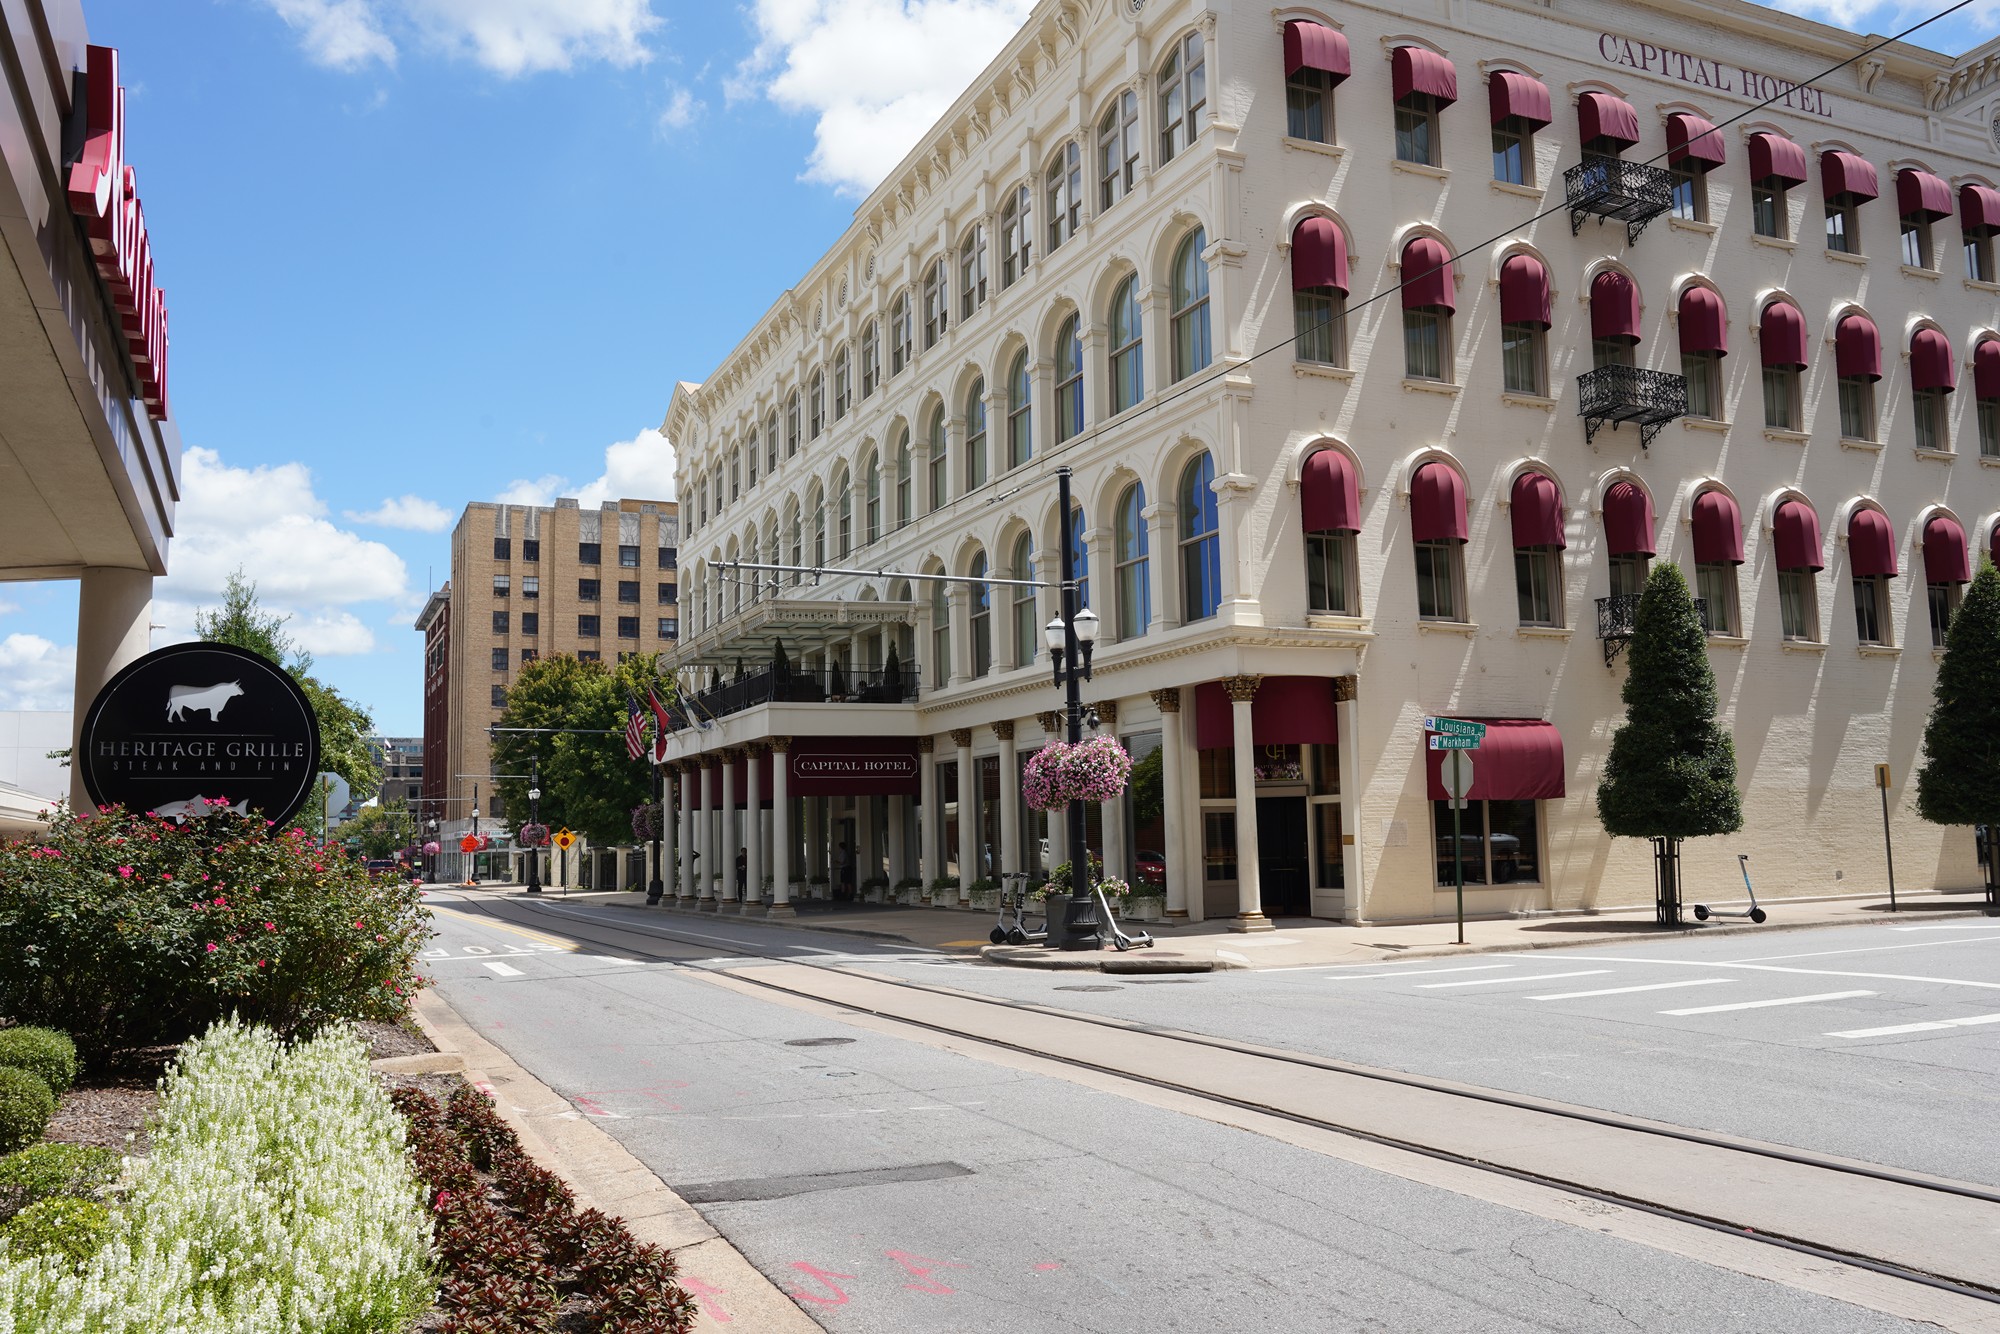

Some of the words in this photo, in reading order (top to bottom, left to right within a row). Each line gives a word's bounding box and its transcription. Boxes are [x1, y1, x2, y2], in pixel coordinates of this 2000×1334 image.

[1599, 32, 1731, 92] CAPITAL
[1739, 68, 1832, 118] HOTEL
[1440, 720, 1475, 735] Louisiana
[100, 740, 216, 757] HERITAGE
[226, 742, 304, 757] GRILLE
[1443, 737, 1471, 748] Markham
[113, 760, 178, 771] STEAK
[200, 760, 236, 771] AND
[258, 760, 290, 771] FIN
[800, 761, 860, 771] CAPITAL
[864, 761, 911, 771] HOTEL
